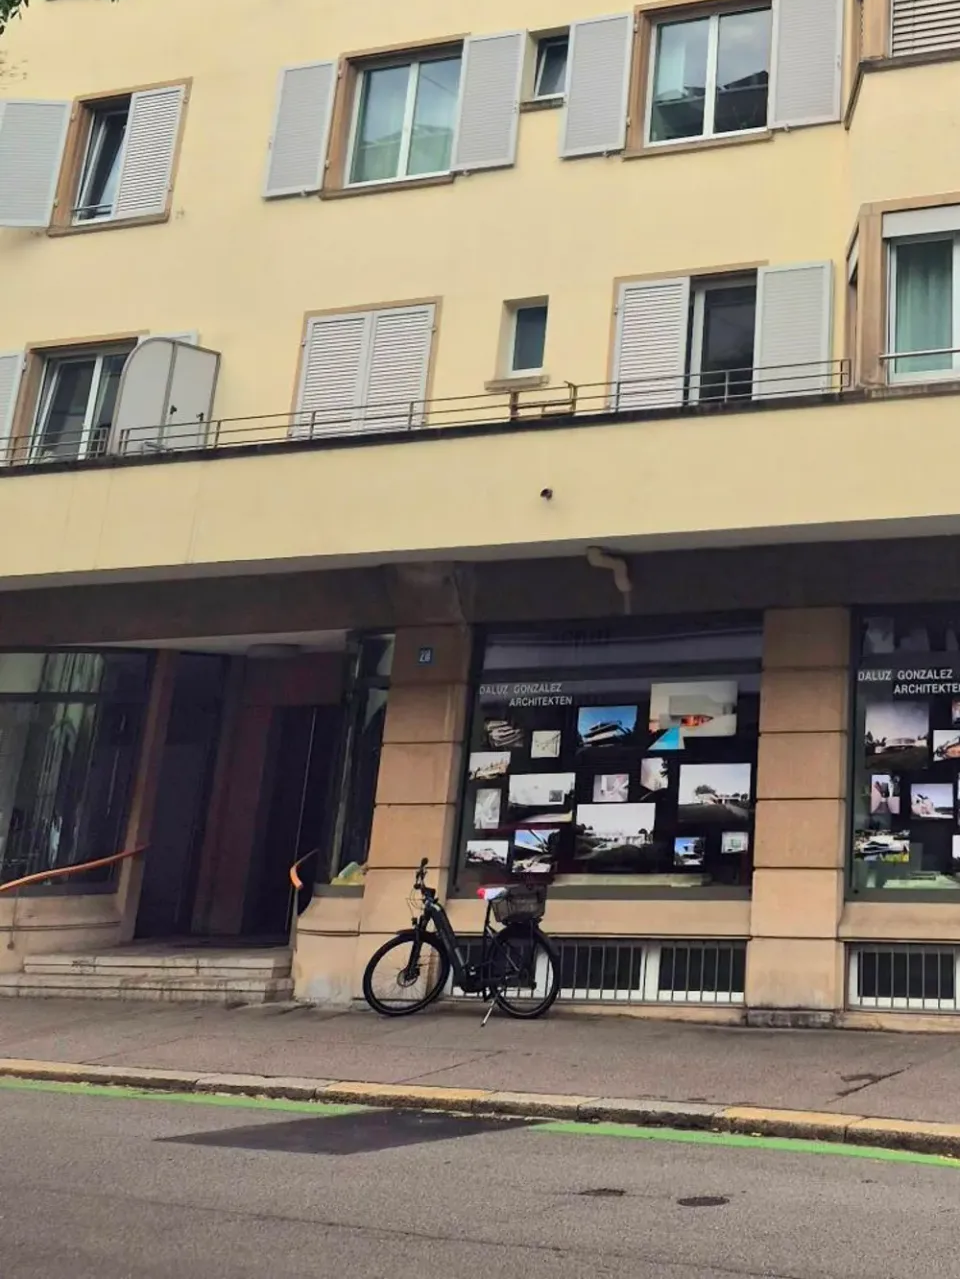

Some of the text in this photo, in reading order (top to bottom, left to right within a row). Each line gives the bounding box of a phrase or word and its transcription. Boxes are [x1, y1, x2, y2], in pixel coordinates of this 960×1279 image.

[857, 668, 953, 682] DALUZ GONZALEZ
[480, 682, 563, 695] DALUZ GONZALEZ
[508, 695, 573, 707] ARCHITEKTEN
